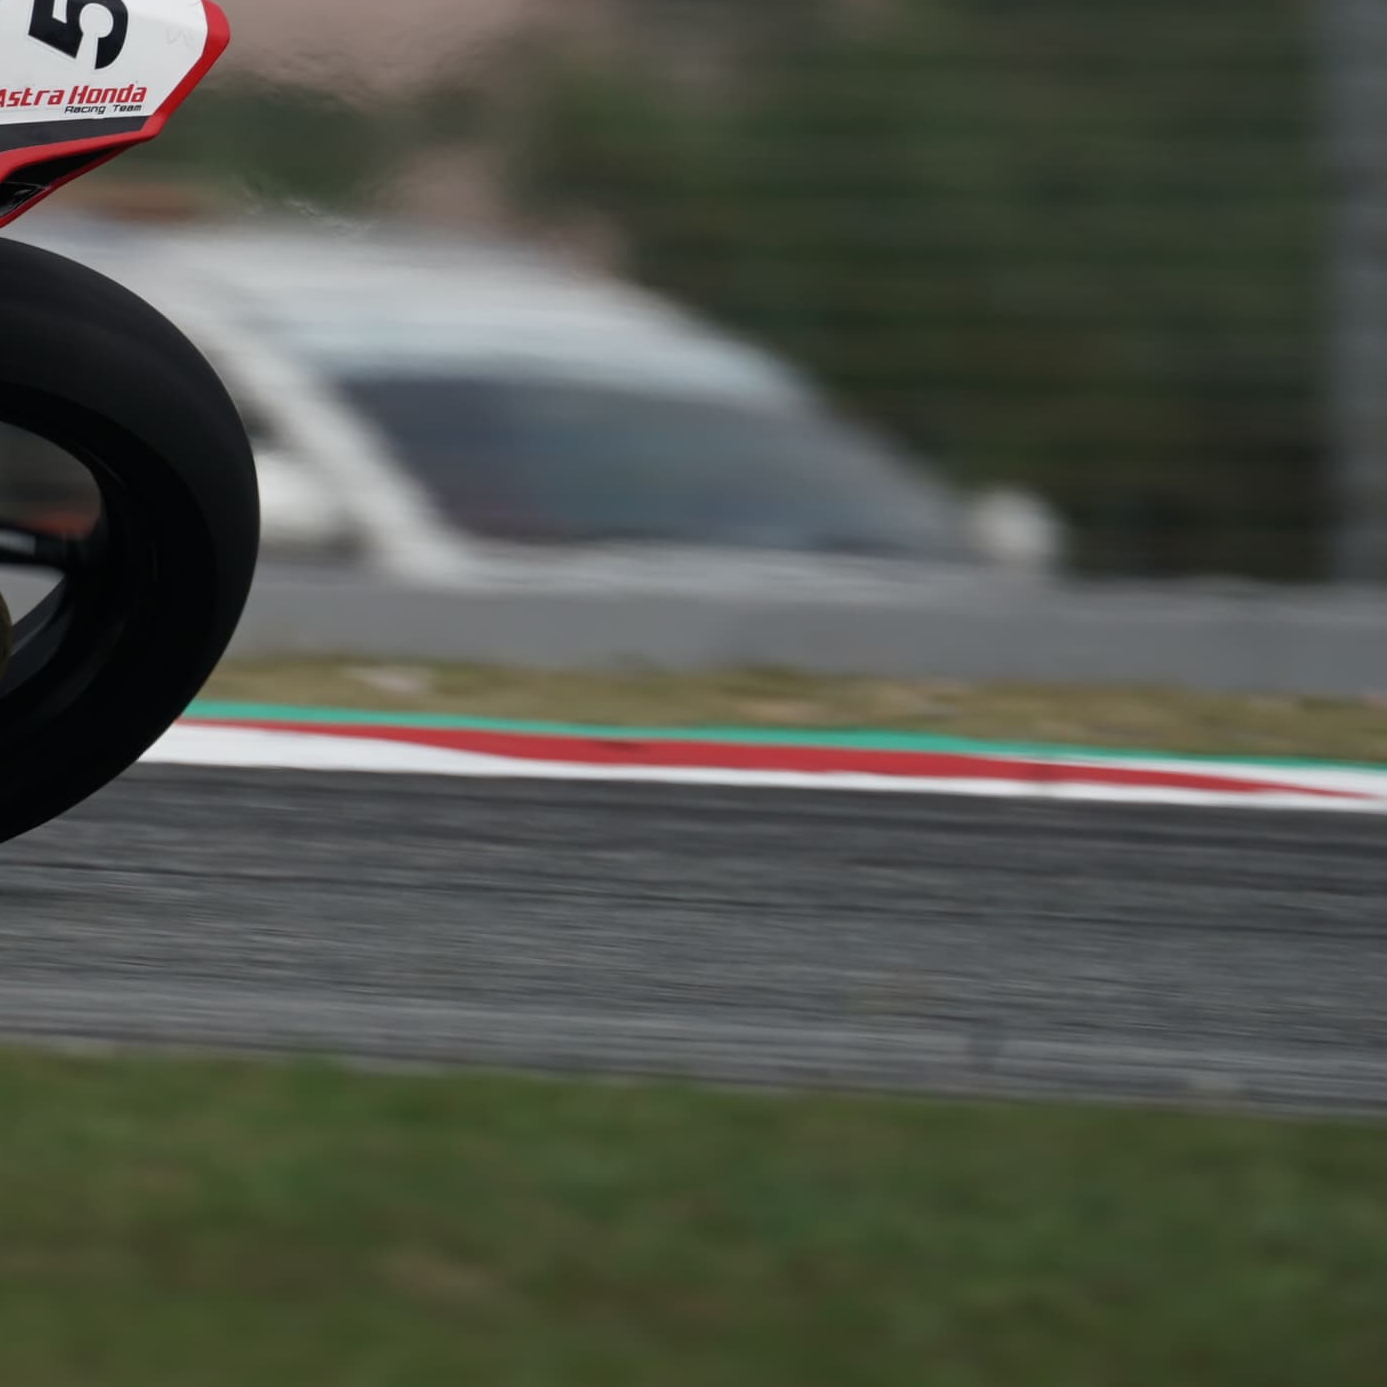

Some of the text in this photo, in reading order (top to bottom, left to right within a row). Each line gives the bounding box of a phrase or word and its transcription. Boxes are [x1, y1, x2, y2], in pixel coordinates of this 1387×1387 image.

[68, 83, 147, 104] Honda
[64, 104, 142, 114] Racing Team
